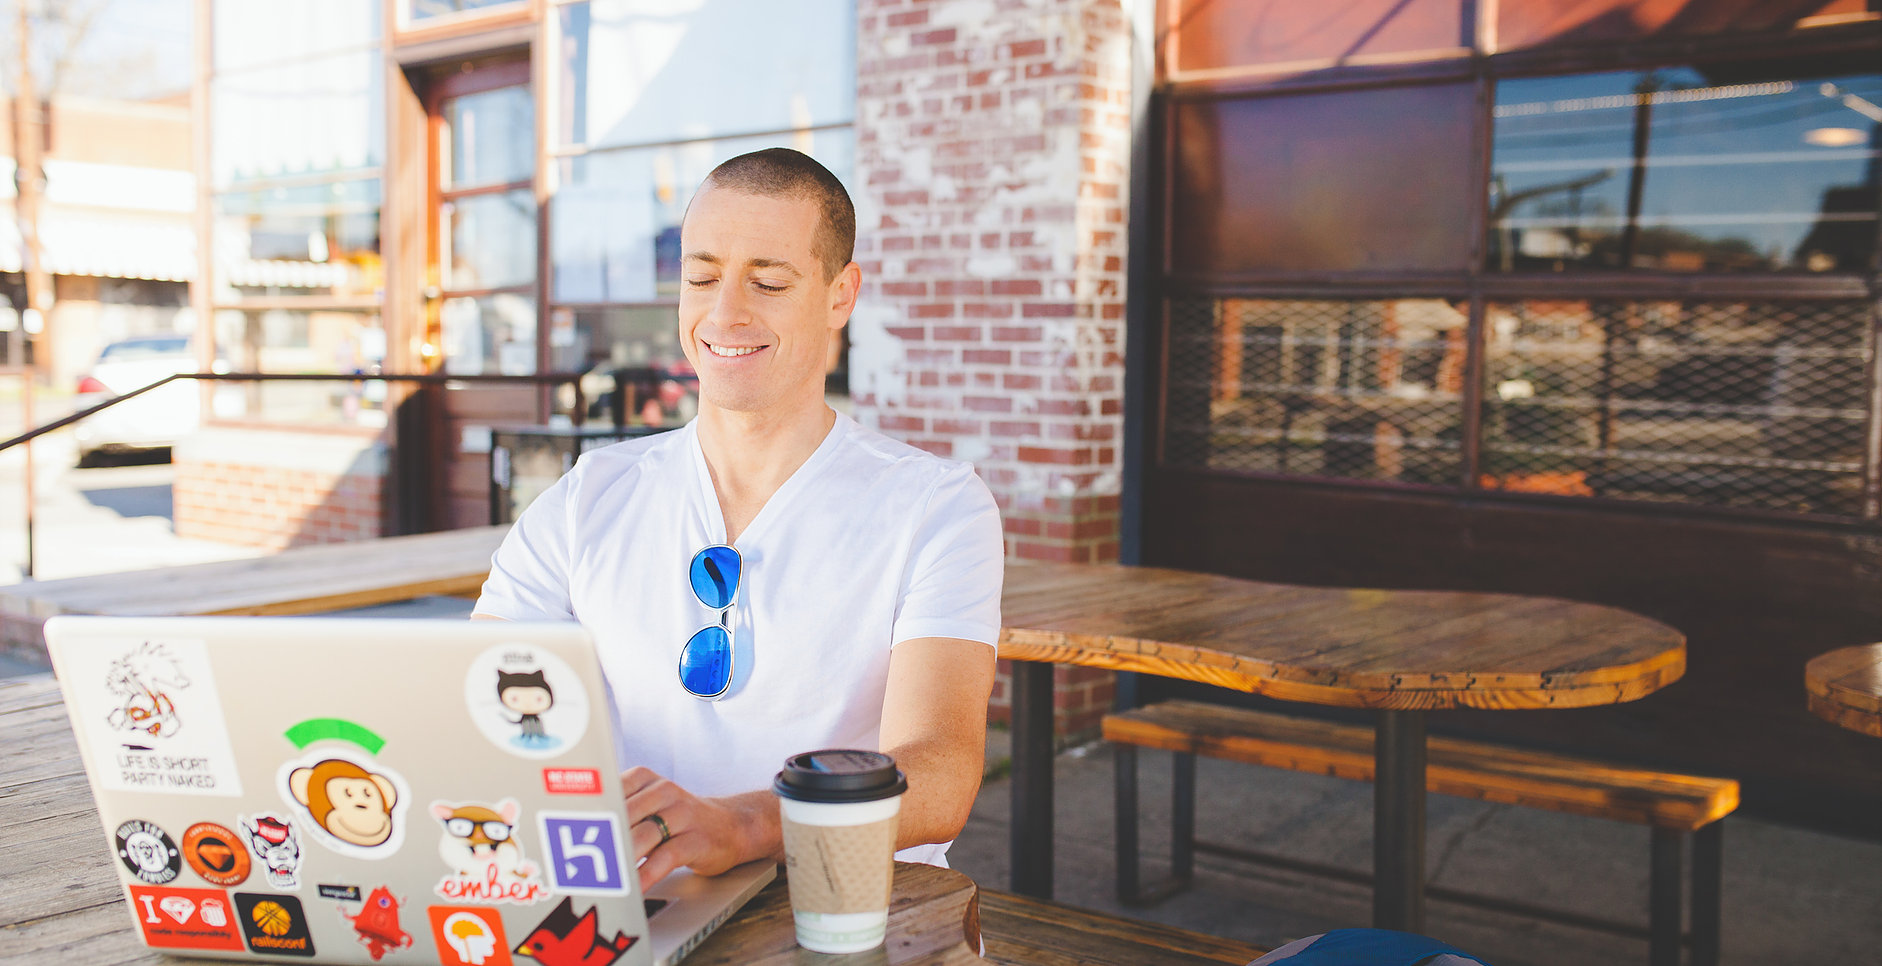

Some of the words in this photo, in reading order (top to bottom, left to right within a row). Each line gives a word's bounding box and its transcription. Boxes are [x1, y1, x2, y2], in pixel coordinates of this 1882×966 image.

[149, 756, 161, 769] IS
[163, 756, 209, 770] SHORT
[121, 771, 164, 785] PARTY
[168, 774, 216, 788] NAKED
[443, 863, 548, 901] ember
[251, 935, 306, 949] railsconf
